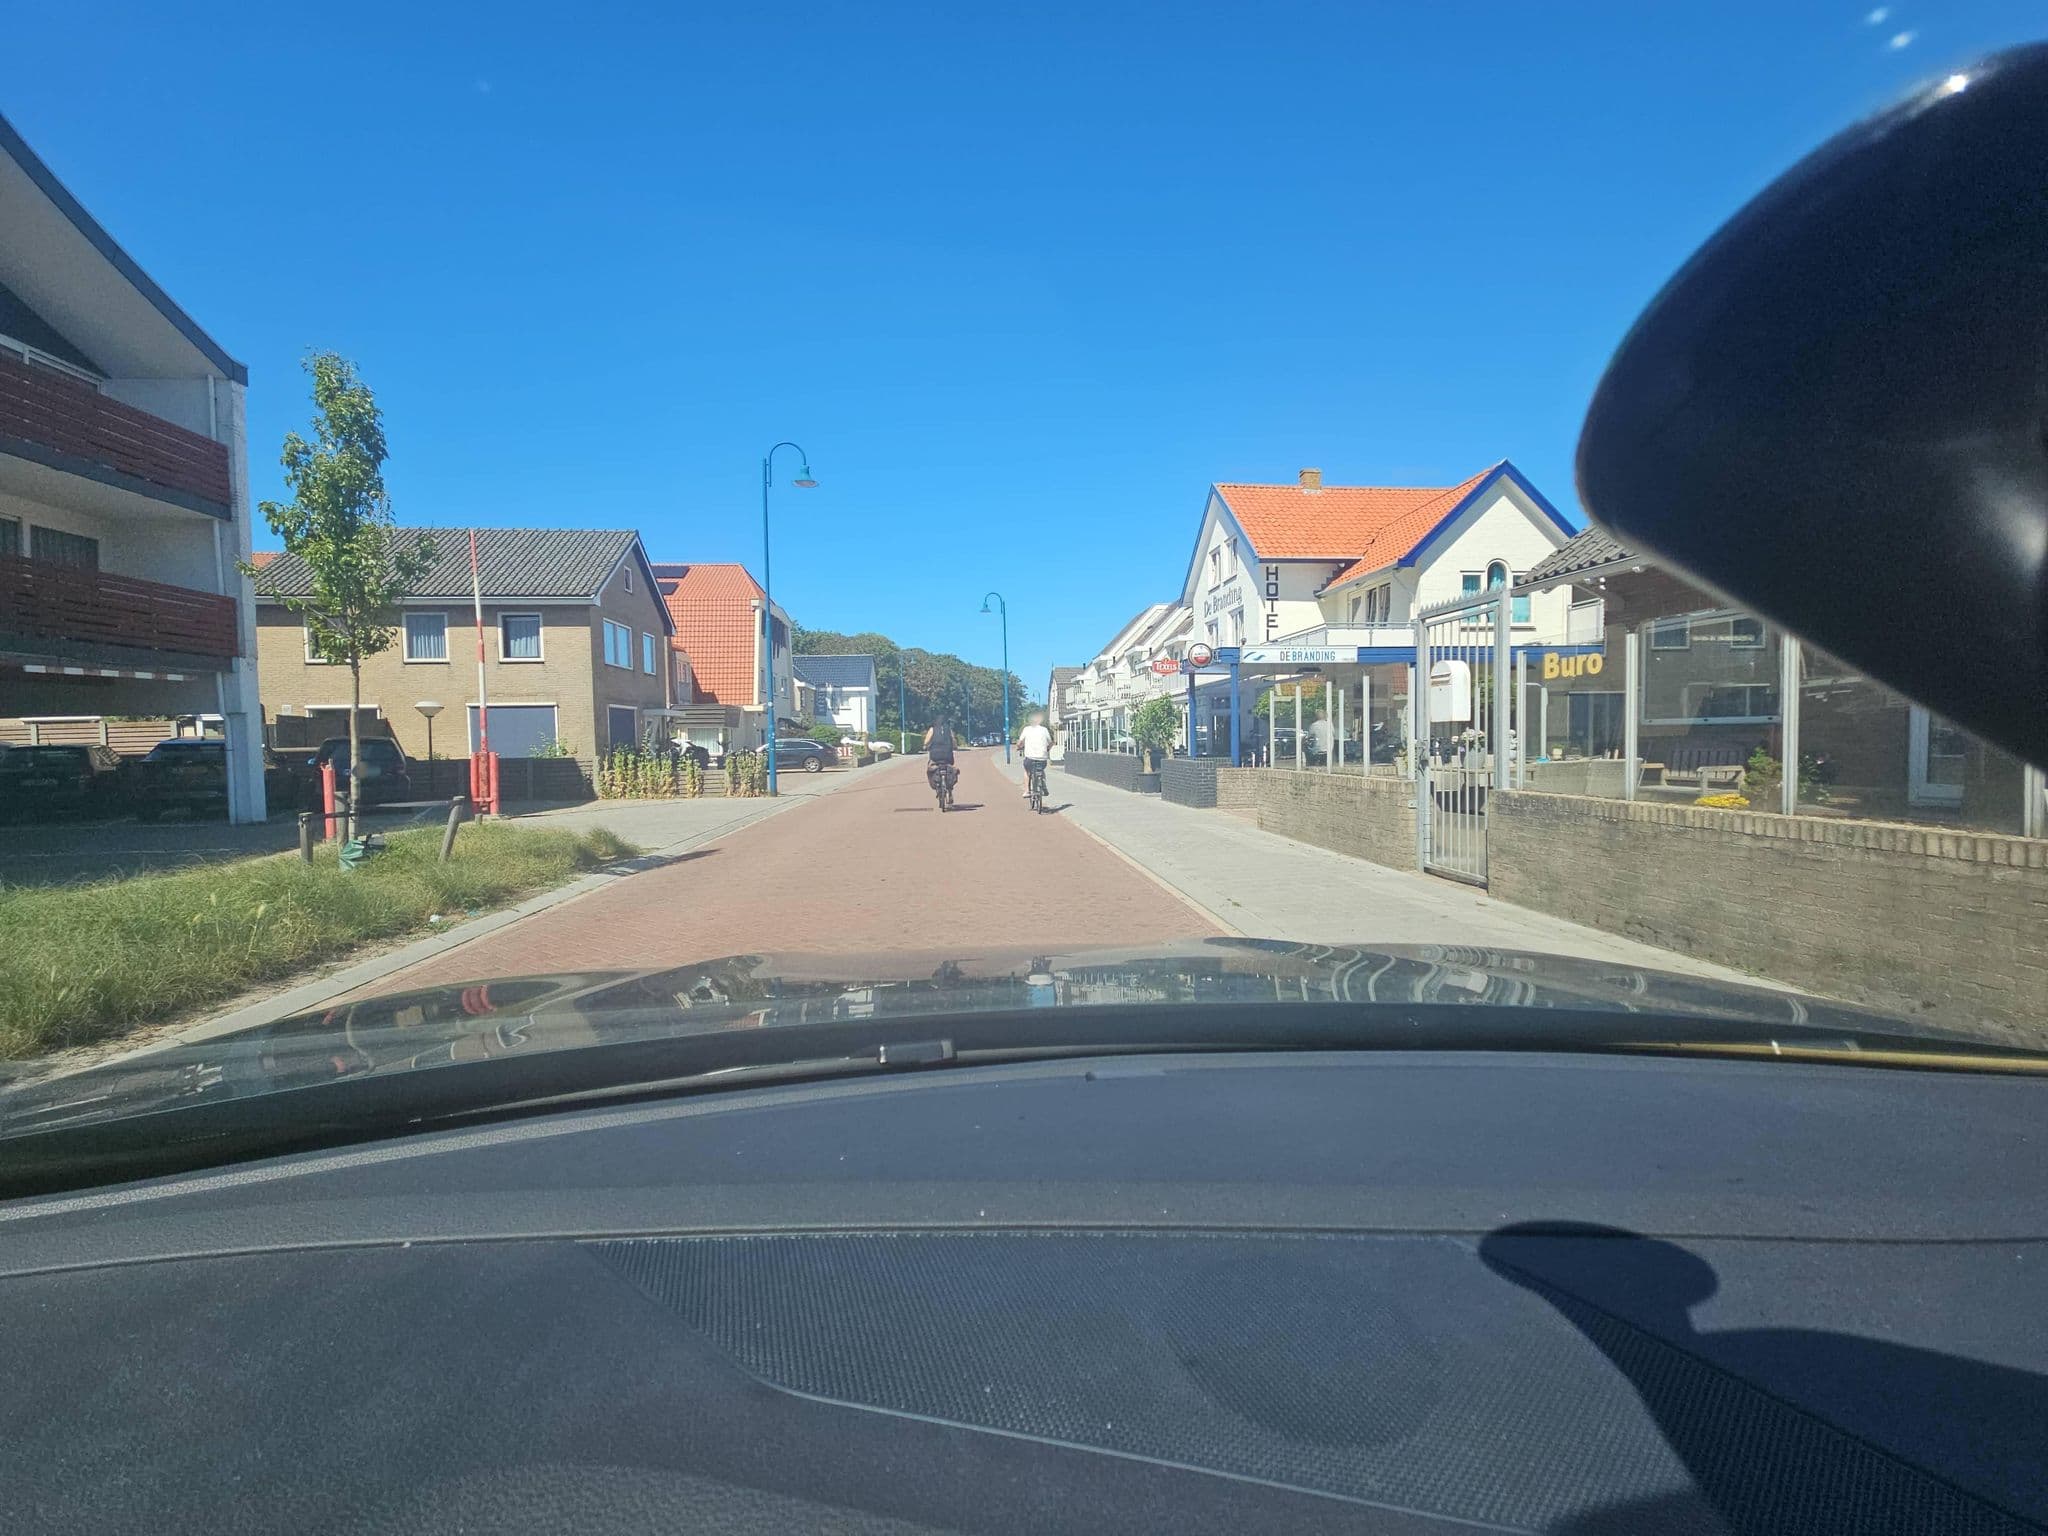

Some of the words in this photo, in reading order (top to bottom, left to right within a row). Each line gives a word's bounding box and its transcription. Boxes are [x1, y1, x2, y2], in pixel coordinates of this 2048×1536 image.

[1203, 600, 1212, 618] De
[1212, 585, 1243, 614] Branding
[1265, 565, 1279, 642] HOTEL
[1279, 650, 1291, 661] DE
[1292, 650, 1336, 662] BRANDING
[1543, 652, 1603, 679] Buro
